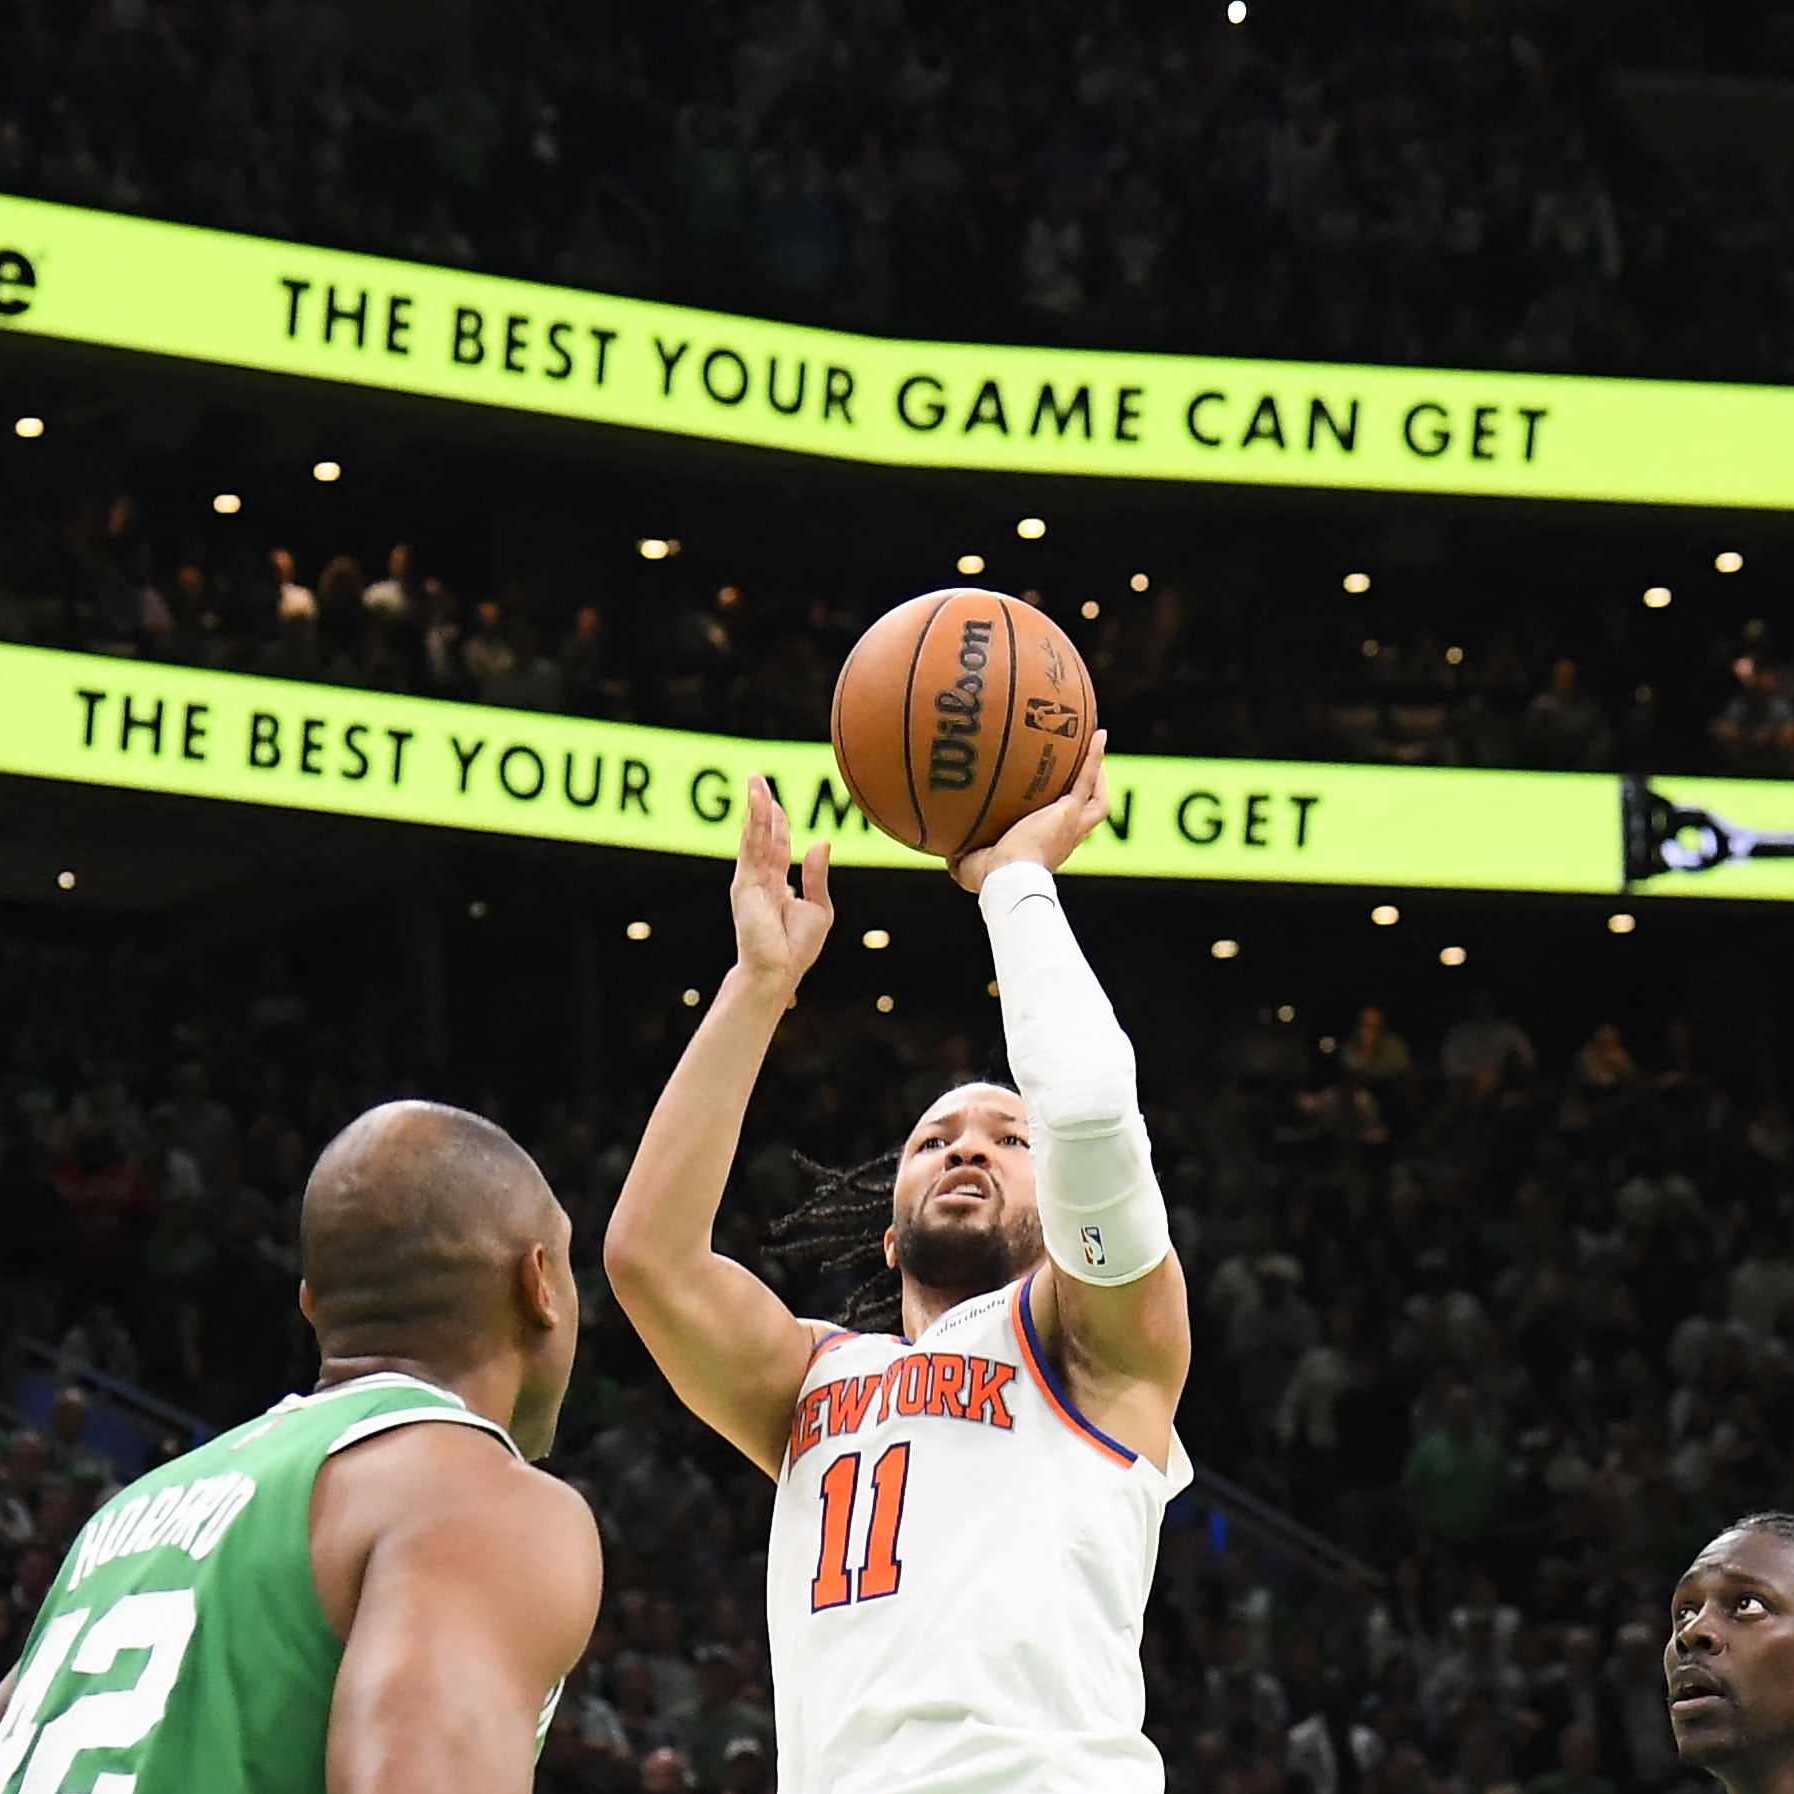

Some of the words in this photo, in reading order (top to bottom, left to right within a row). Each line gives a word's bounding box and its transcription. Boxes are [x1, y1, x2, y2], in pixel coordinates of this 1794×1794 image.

[281, 278, 411, 355] THE
[452, 307, 618, 386] BEST
[655, 336, 855, 424] YOUR
[896, 375, 1143, 442] GAME
[1186, 390, 1359, 452] CAN
[1404, 402, 1547, 463] GET
[76, 689, 209, 760] THE
[248, 711, 414, 785] BEST
[450, 736, 651, 814] YOUR
[929, 619, 993, 792] Wilson
[1177, 790, 1317, 848] GET
[787, 1373, 884, 1484] NEW
[876, 1352, 1017, 1433] YORK
[811, 1440, 911, 1615] 11
